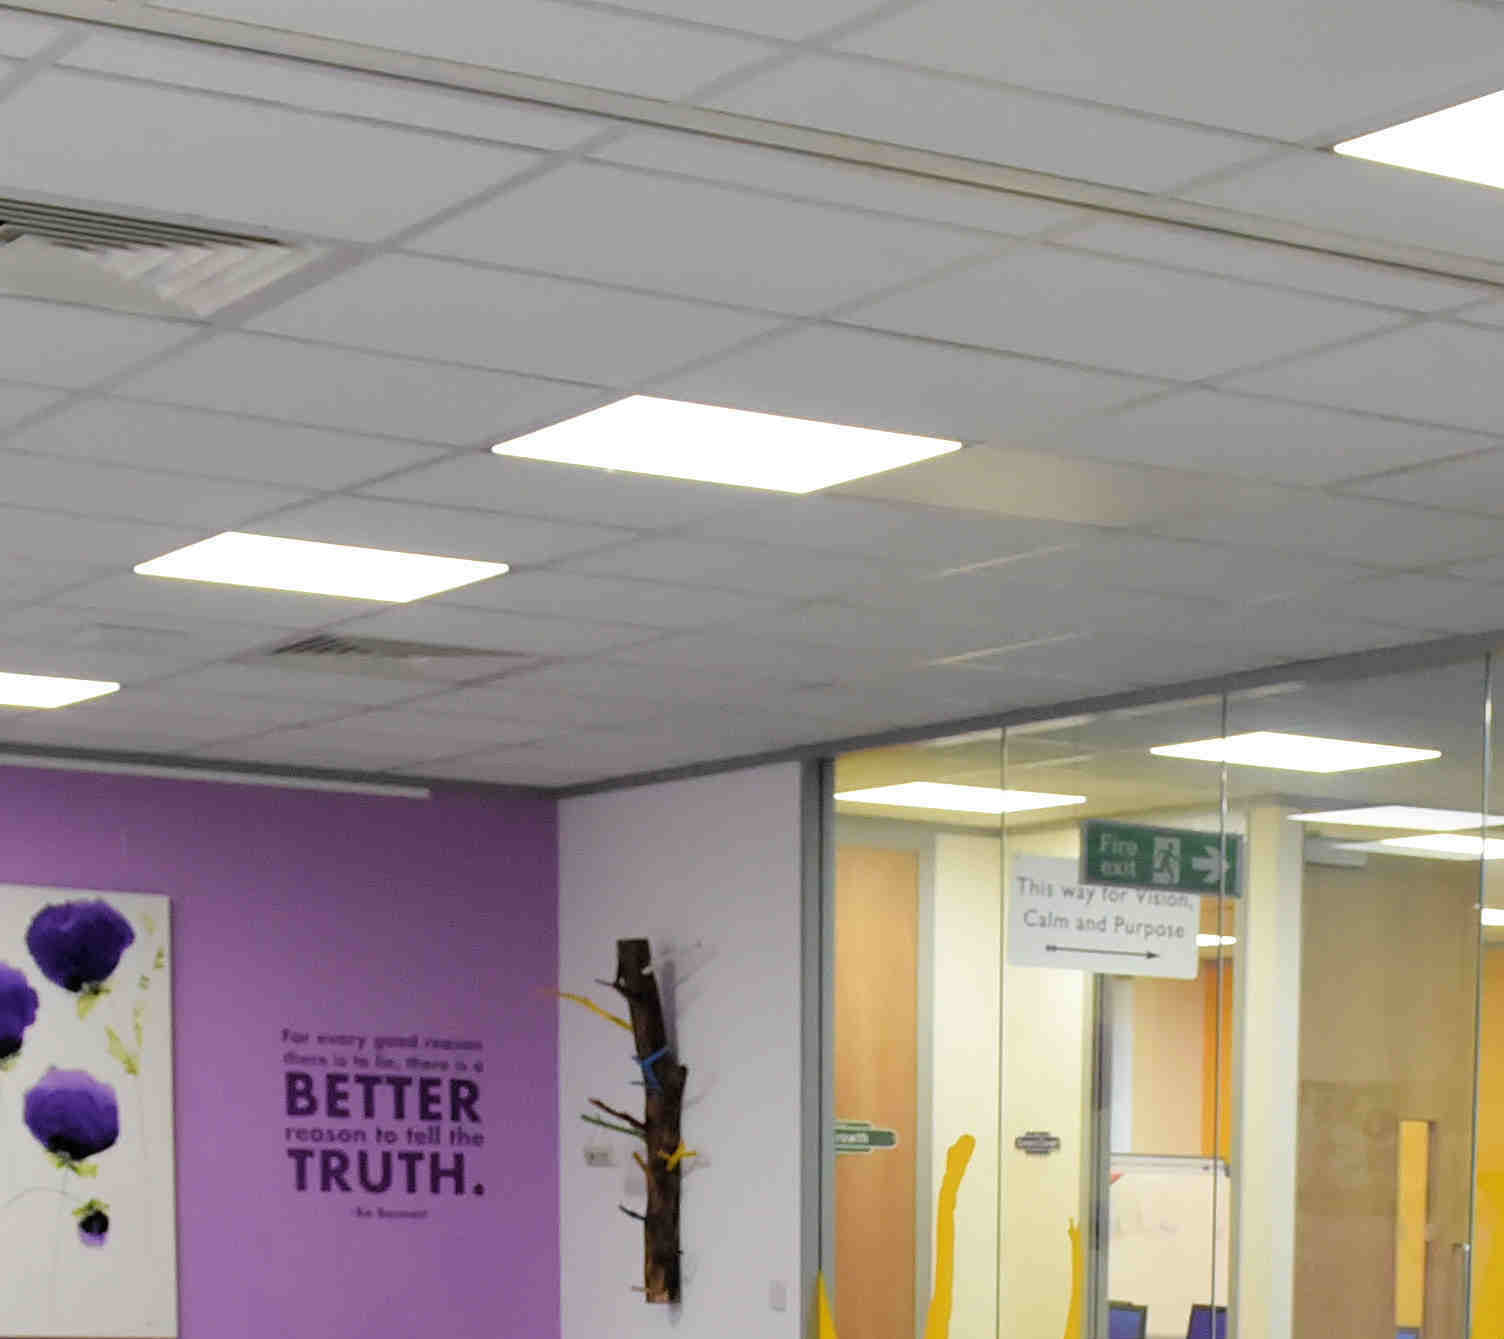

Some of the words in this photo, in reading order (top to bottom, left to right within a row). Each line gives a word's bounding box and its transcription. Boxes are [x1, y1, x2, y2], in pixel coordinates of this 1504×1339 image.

[1100, 833, 1138, 856] Fire
[1100, 859, 1137, 879] exit
[1016, 877, 1054, 898] This
[1062, 885, 1094, 906] way
[1102, 884, 1128, 904] for
[1023, 908, 1069, 931] Calm
[1076, 913, 1106, 934] and
[1114, 916, 1185, 940] Purpose
[285, 1072, 482, 1123] BETTER
[285, 1126, 367, 1145] reason
[376, 1125, 399, 1145] to
[407, 1126, 441, 1146] tell
[450, 1126, 485, 1147] the
[287, 1149, 486, 1196] TRUTH.
